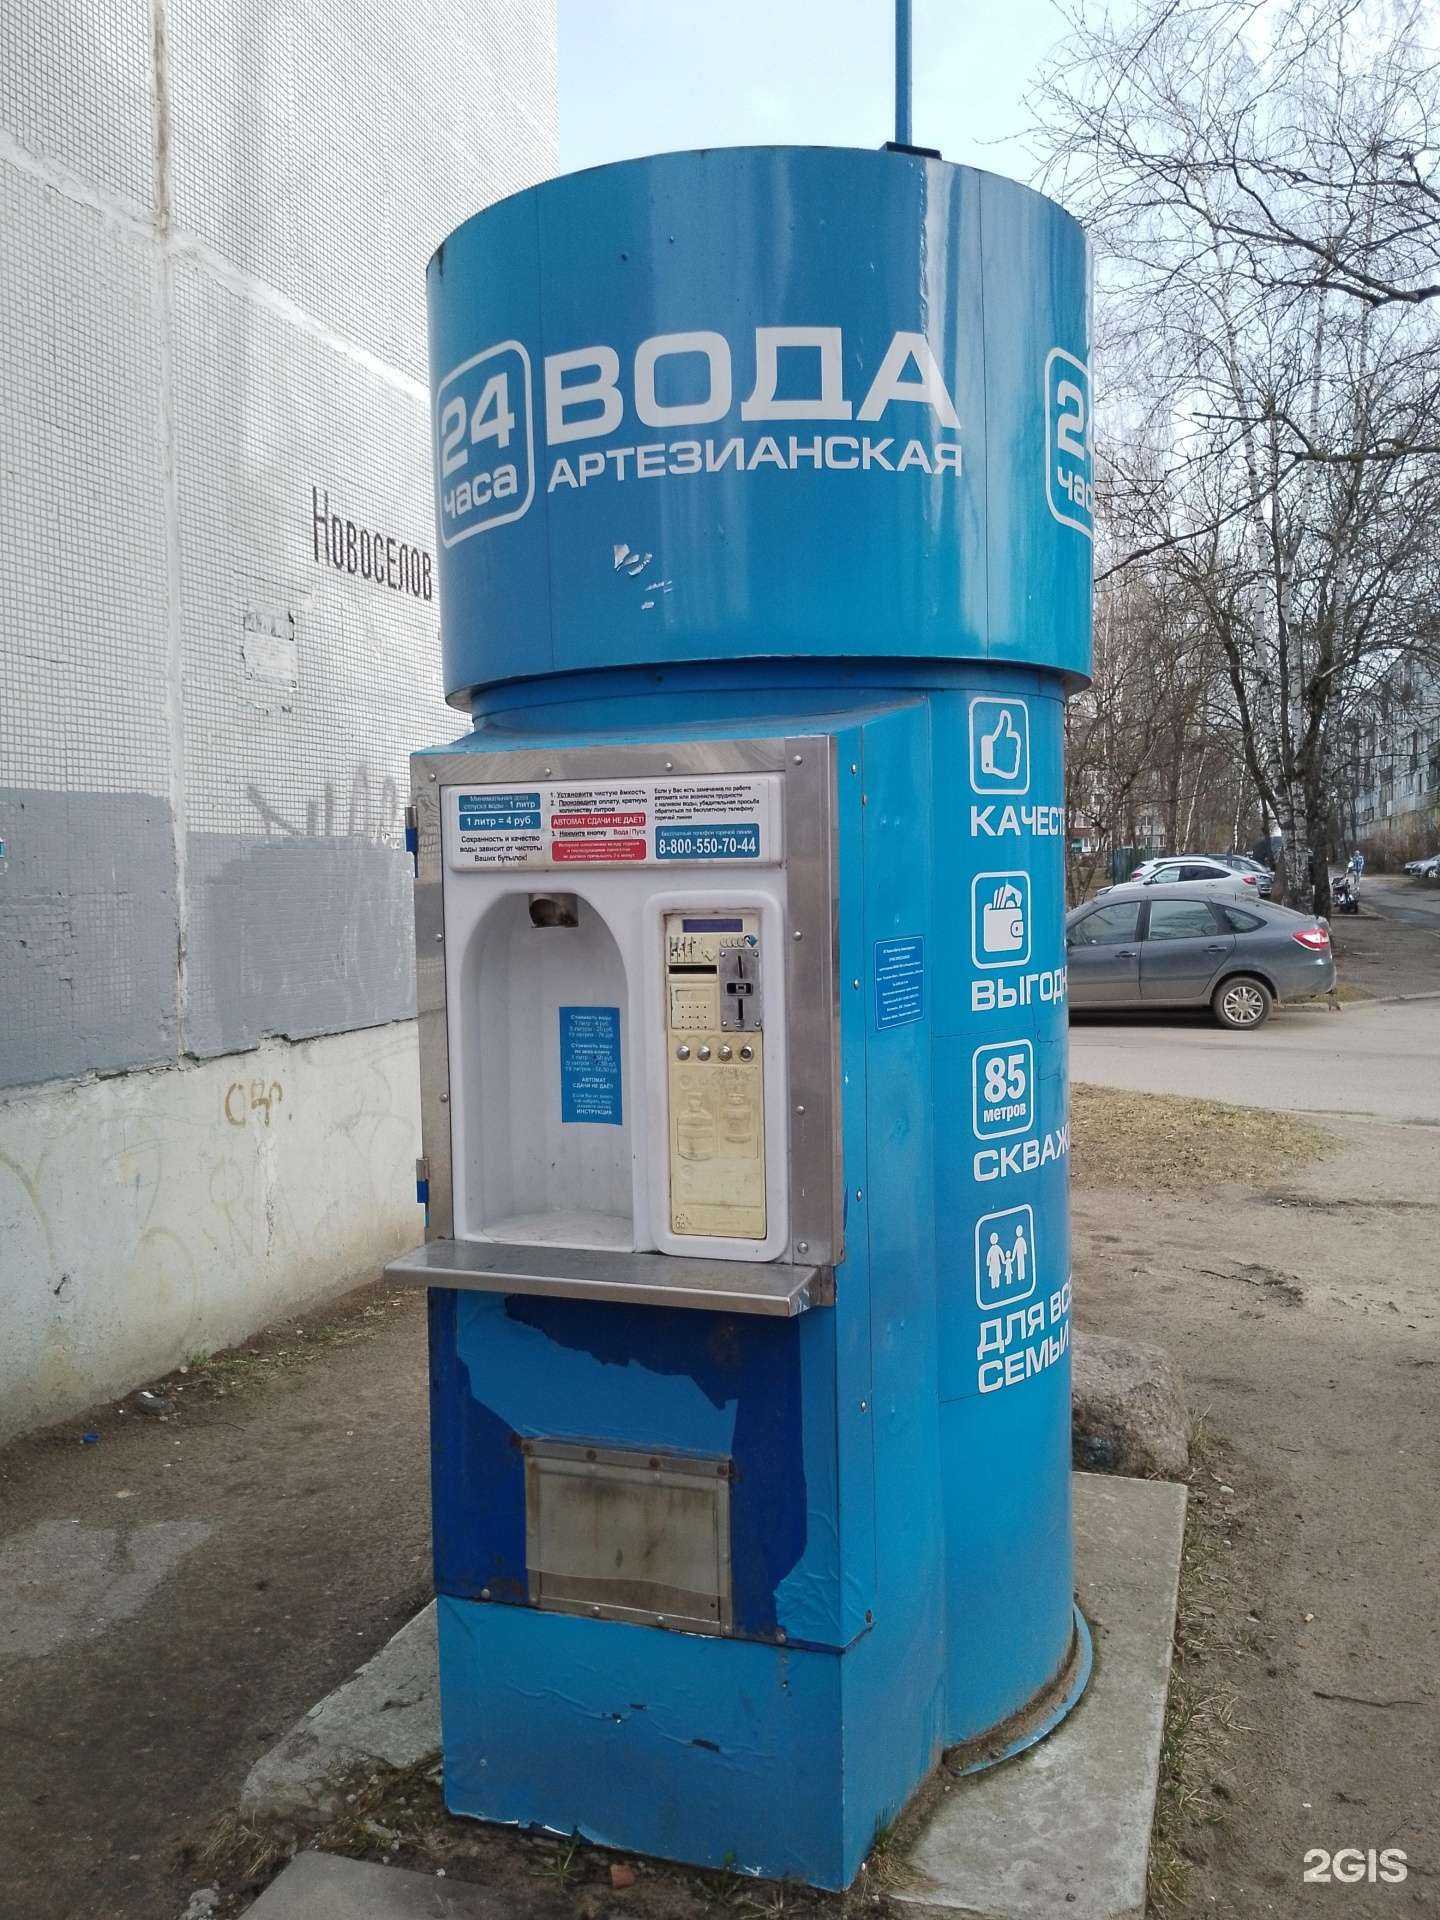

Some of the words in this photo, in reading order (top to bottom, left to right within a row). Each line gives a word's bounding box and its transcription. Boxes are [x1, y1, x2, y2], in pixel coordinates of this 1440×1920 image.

[544, 326, 962, 446] ВОДА
[442, 372, 515, 478] 24
[1057, 380, 1093, 461] 2
[444, 464, 518, 519] часа
[547, 436, 962, 493] АРТЕЗИАНСКАЯ
[514, 816, 533, 826] руб.
[553, 817, 585, 826] АВТОМАТ
[587, 817, 610, 825] СДАЧИ
[659, 837, 756, 854] 8-800-550-70-44
[970, 805, 1065, 837] КАЧЕСТ
[984, 1053, 1026, 1103] 85
[983, 1103, 1027, 1123] метров
[977, 1301, 1045, 1360] ДЛЯ
[978, 1319, 1069, 1394] СЕМЬИ
